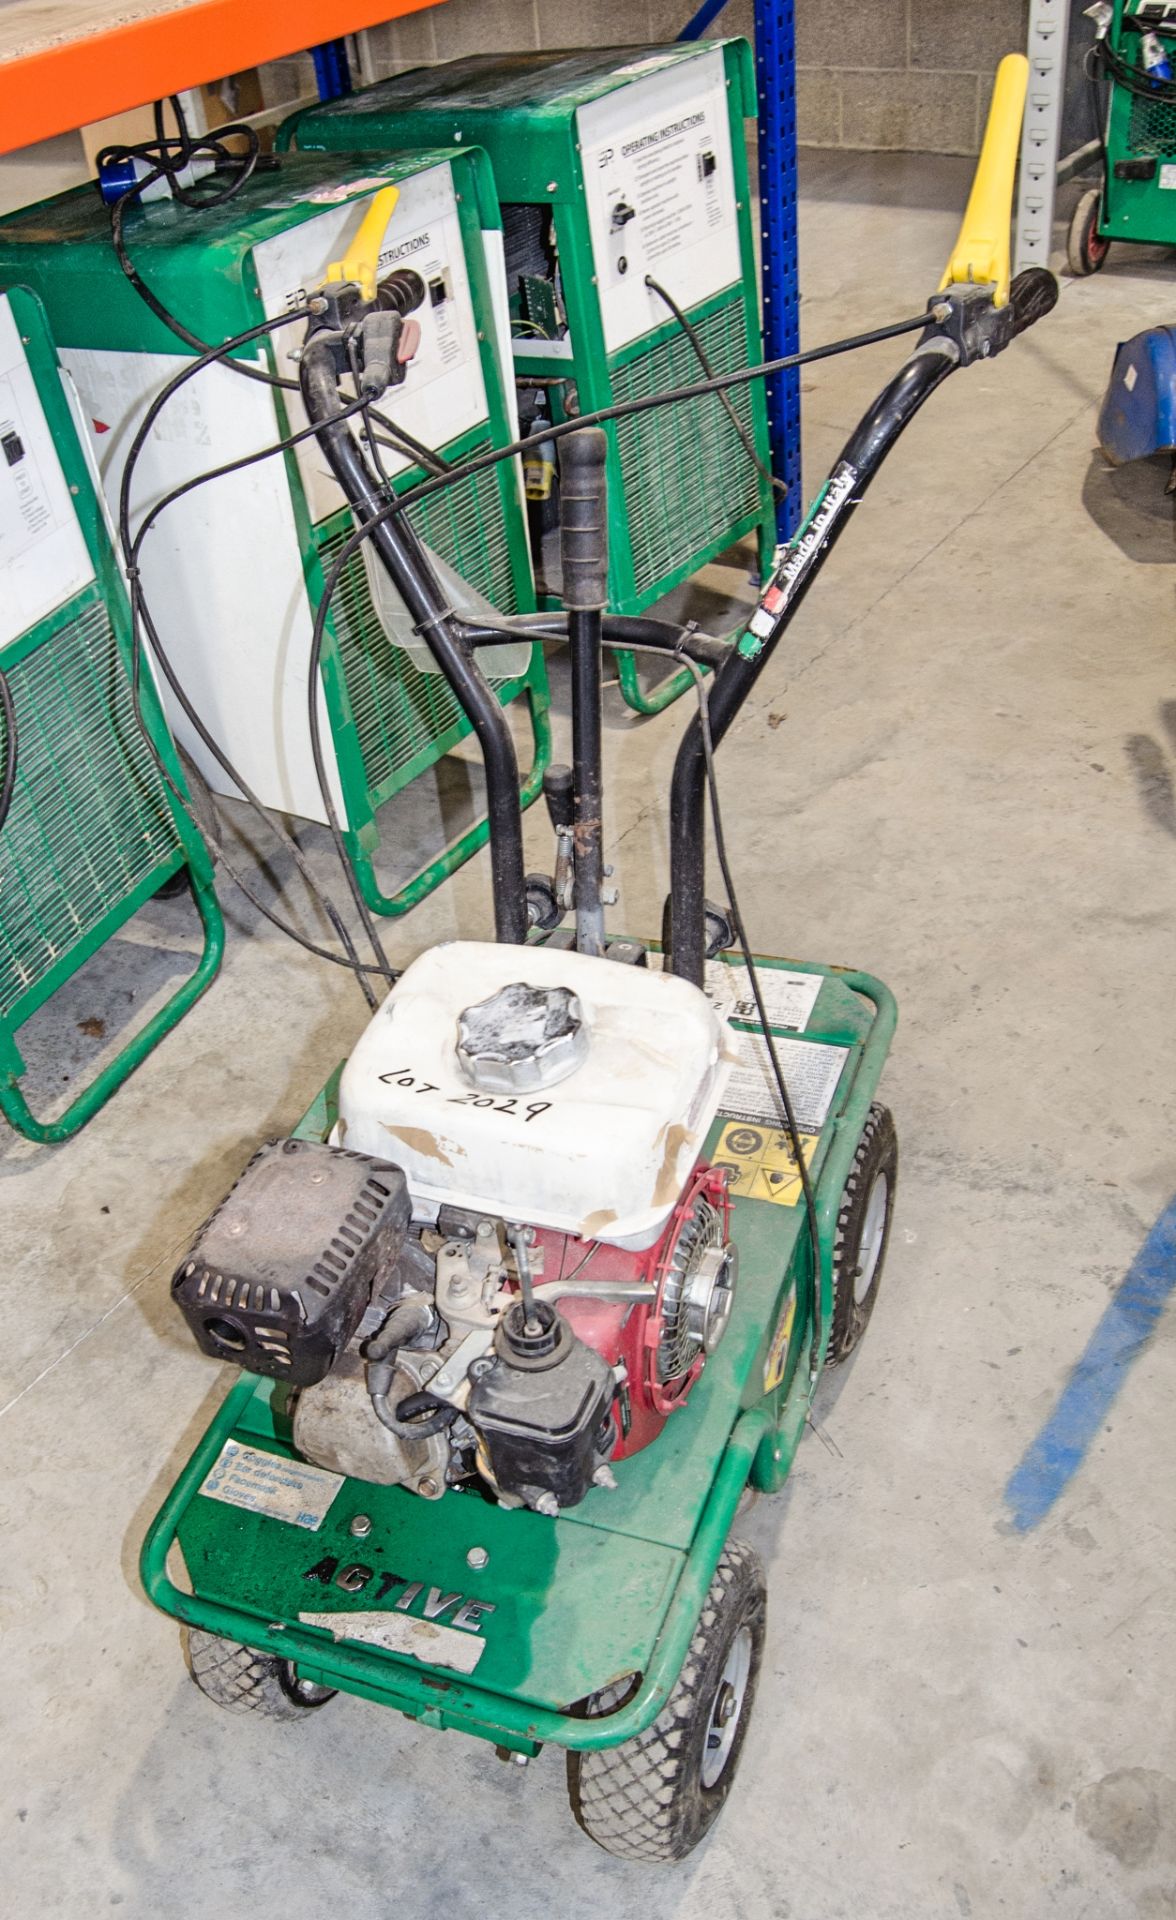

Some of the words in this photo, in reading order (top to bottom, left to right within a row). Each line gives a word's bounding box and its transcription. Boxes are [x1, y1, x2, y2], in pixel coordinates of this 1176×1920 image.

[621, 131, 658, 156] OPERATING
[660, 111, 705, 139] INSTRUCTIONS
[376, 233, 430, 267] STRUCTIONS
[784, 533, 816, 580] Made
[810, 513, 827, 529] in
[824, 472, 854, 510] Italy
[378, 1068, 440, 1093] LOT
[446, 1093, 553, 1122] 2029
[717, 1110, 761, 1123] INSTRUCT
[243, 1451, 281, 1469] Goggles
[223, 1485, 257, 1502] Gloves
[253, 1470, 303, 1490] defenders
[302, 1555, 496, 1631] ACTIVE
